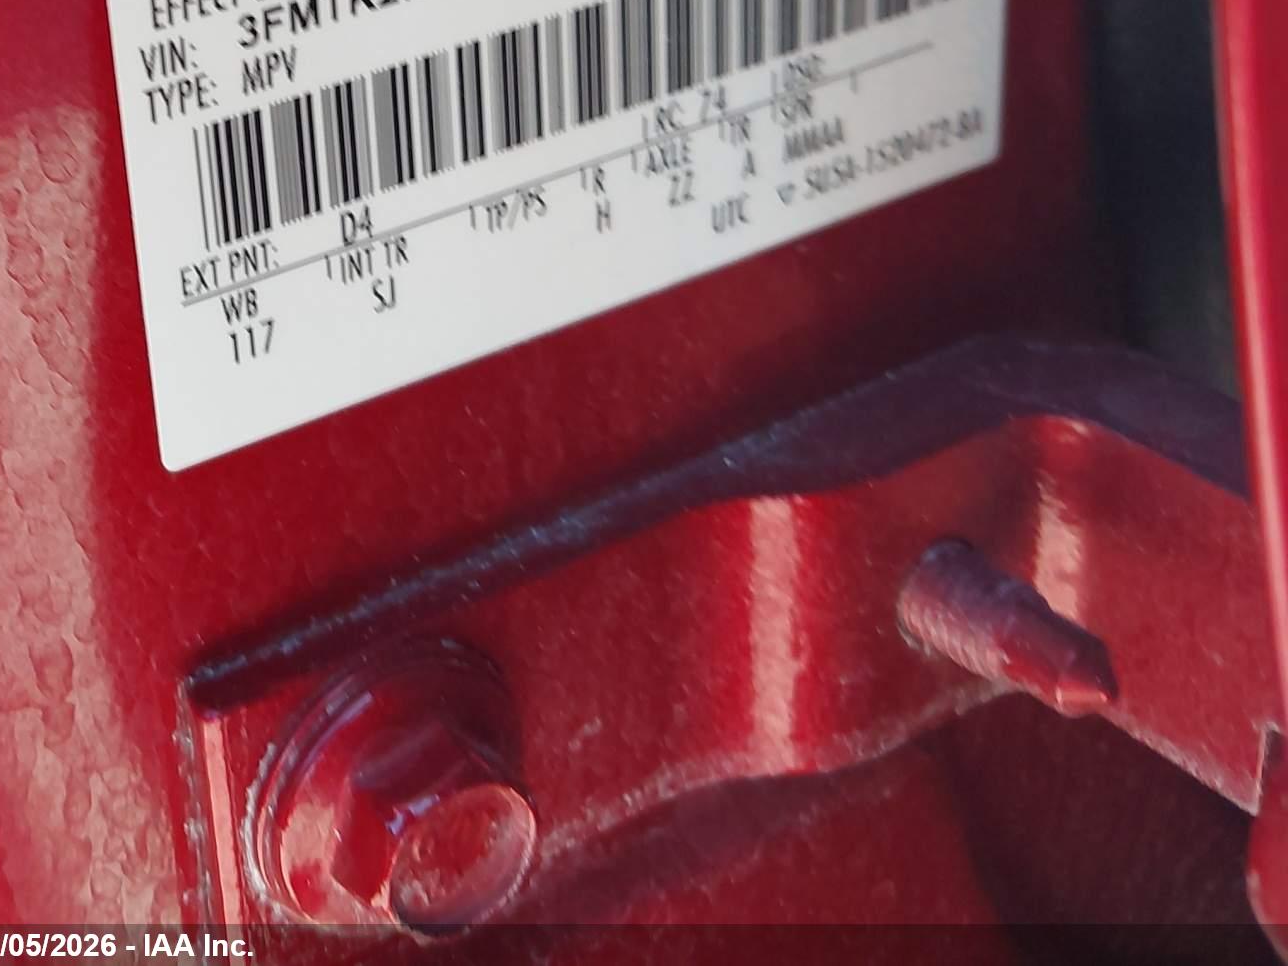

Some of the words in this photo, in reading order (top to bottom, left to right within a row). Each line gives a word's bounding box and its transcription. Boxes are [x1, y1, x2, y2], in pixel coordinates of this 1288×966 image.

[139, 36, 198, 81] VIN:
[144, 73, 219, 124] TYPE:
[242, 45, 297, 95] MPV
[180, 256, 220, 297] EXT
[228, 239, 279, 282] PNT:
[341, 206, 374, 246] D4
[221, 287, 258, 325] WB
[341, 245, 375, 285] INT
[381, 235, 409, 269] TR
[592, 166, 606, 195] R
[644, 136, 692, 177] AXLE
[228, 317, 275, 364] 117
[372, 275, 397, 313] SJ
[595, 199, 612, 234] H
[668, 169, 695, 208] 22
[742, 147, 756, 178] A
[710, 192, 750, 234] UTC
